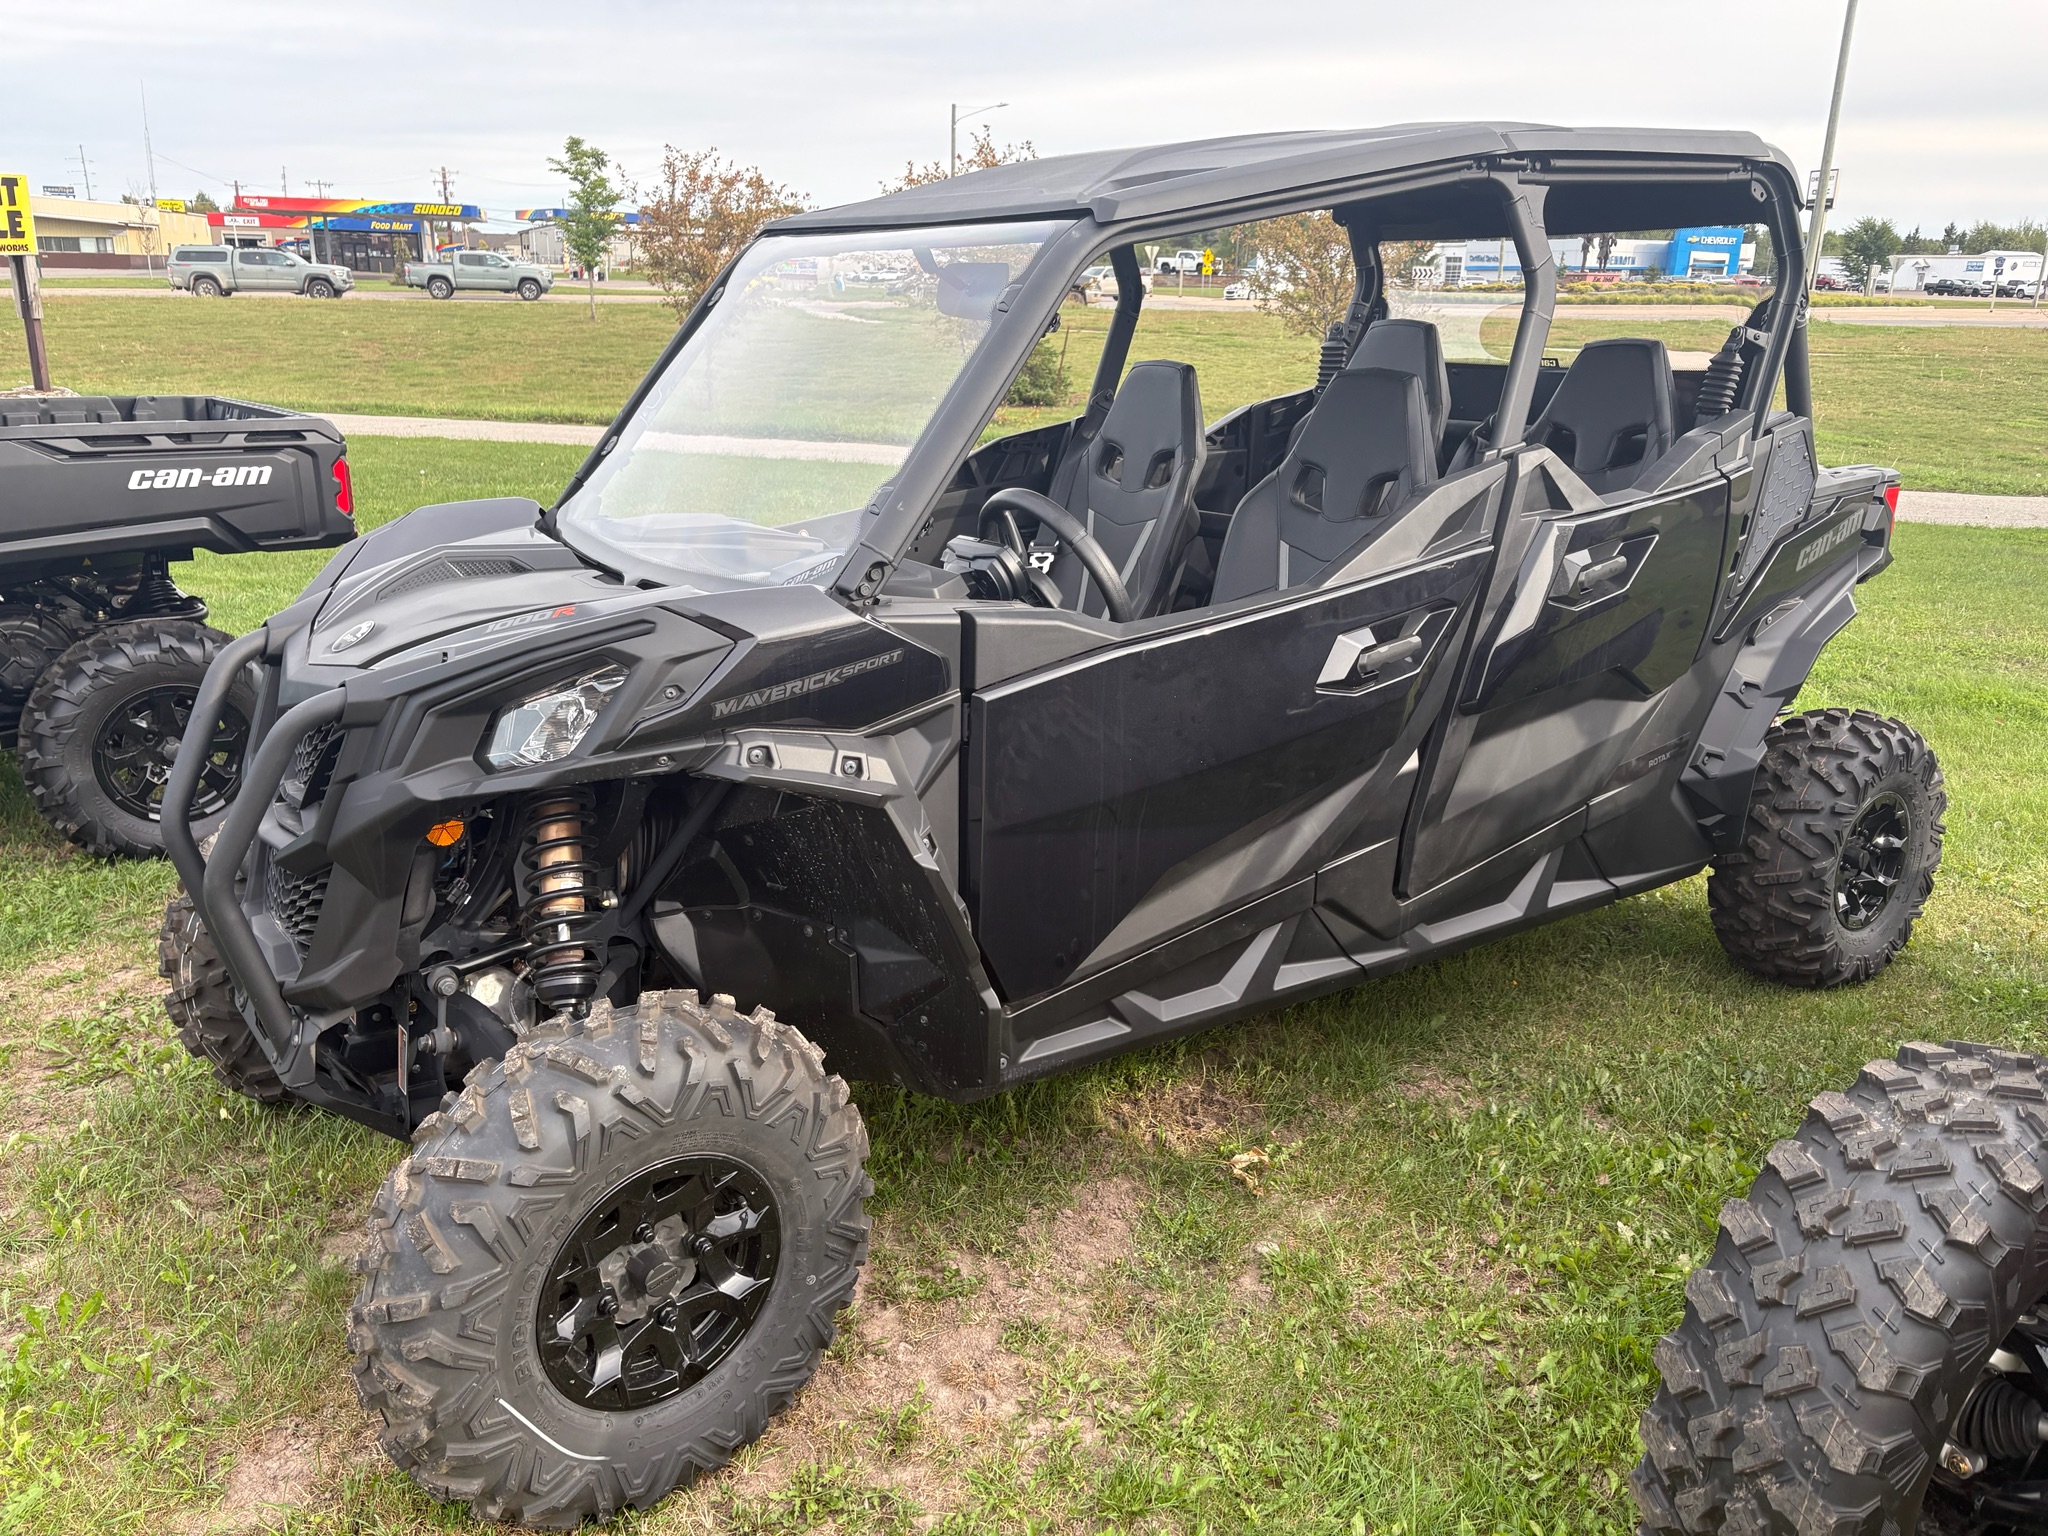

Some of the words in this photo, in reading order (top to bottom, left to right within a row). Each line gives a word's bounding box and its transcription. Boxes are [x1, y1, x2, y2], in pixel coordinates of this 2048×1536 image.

[0, 177, 18, 206] T
[413, 203, 462, 216] SUNOCO
[371, 221, 390, 230] FOOD
[392, 222, 413, 231] MART
[1701, 235, 1737, 245] CHEVROLET
[128, 465, 273, 490] can-am
[1796, 508, 1865, 572] can-am
[483, 606, 577, 635] 1000R
[713, 669, 845, 718] MAVERICK
[840, 649, 904, 678] SPORT
[1648, 751, 1671, 768] ROTAX
[513, 1214, 571, 1385] BIGHORN
